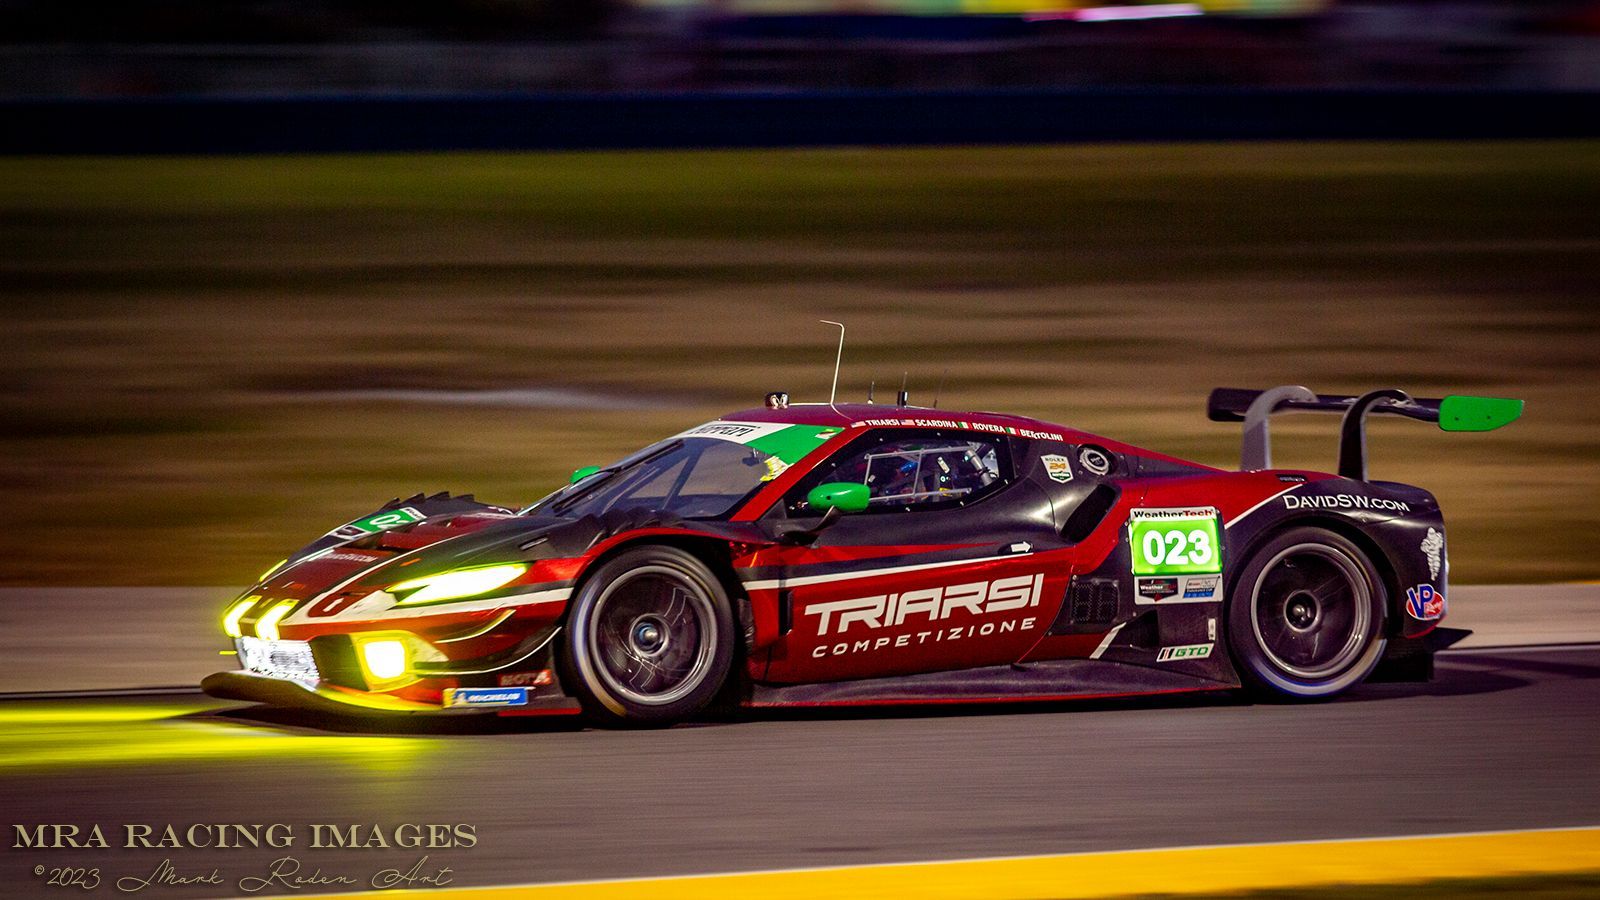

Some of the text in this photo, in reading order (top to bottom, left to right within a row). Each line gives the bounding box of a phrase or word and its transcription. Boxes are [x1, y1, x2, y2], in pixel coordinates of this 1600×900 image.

[865, 418, 1064, 442] TRIARSI SCARDINA ROVERA BERTOLINI
[1133, 509, 1213, 519] WeatherTech
[1142, 529, 1213, 566] 023
[804, 573, 1045, 636] TRIARSI
[1406, 583, 1435, 619] VP
[811, 617, 1037, 658] COMPETIZIONE
[1174, 646, 1209, 657] GTD
